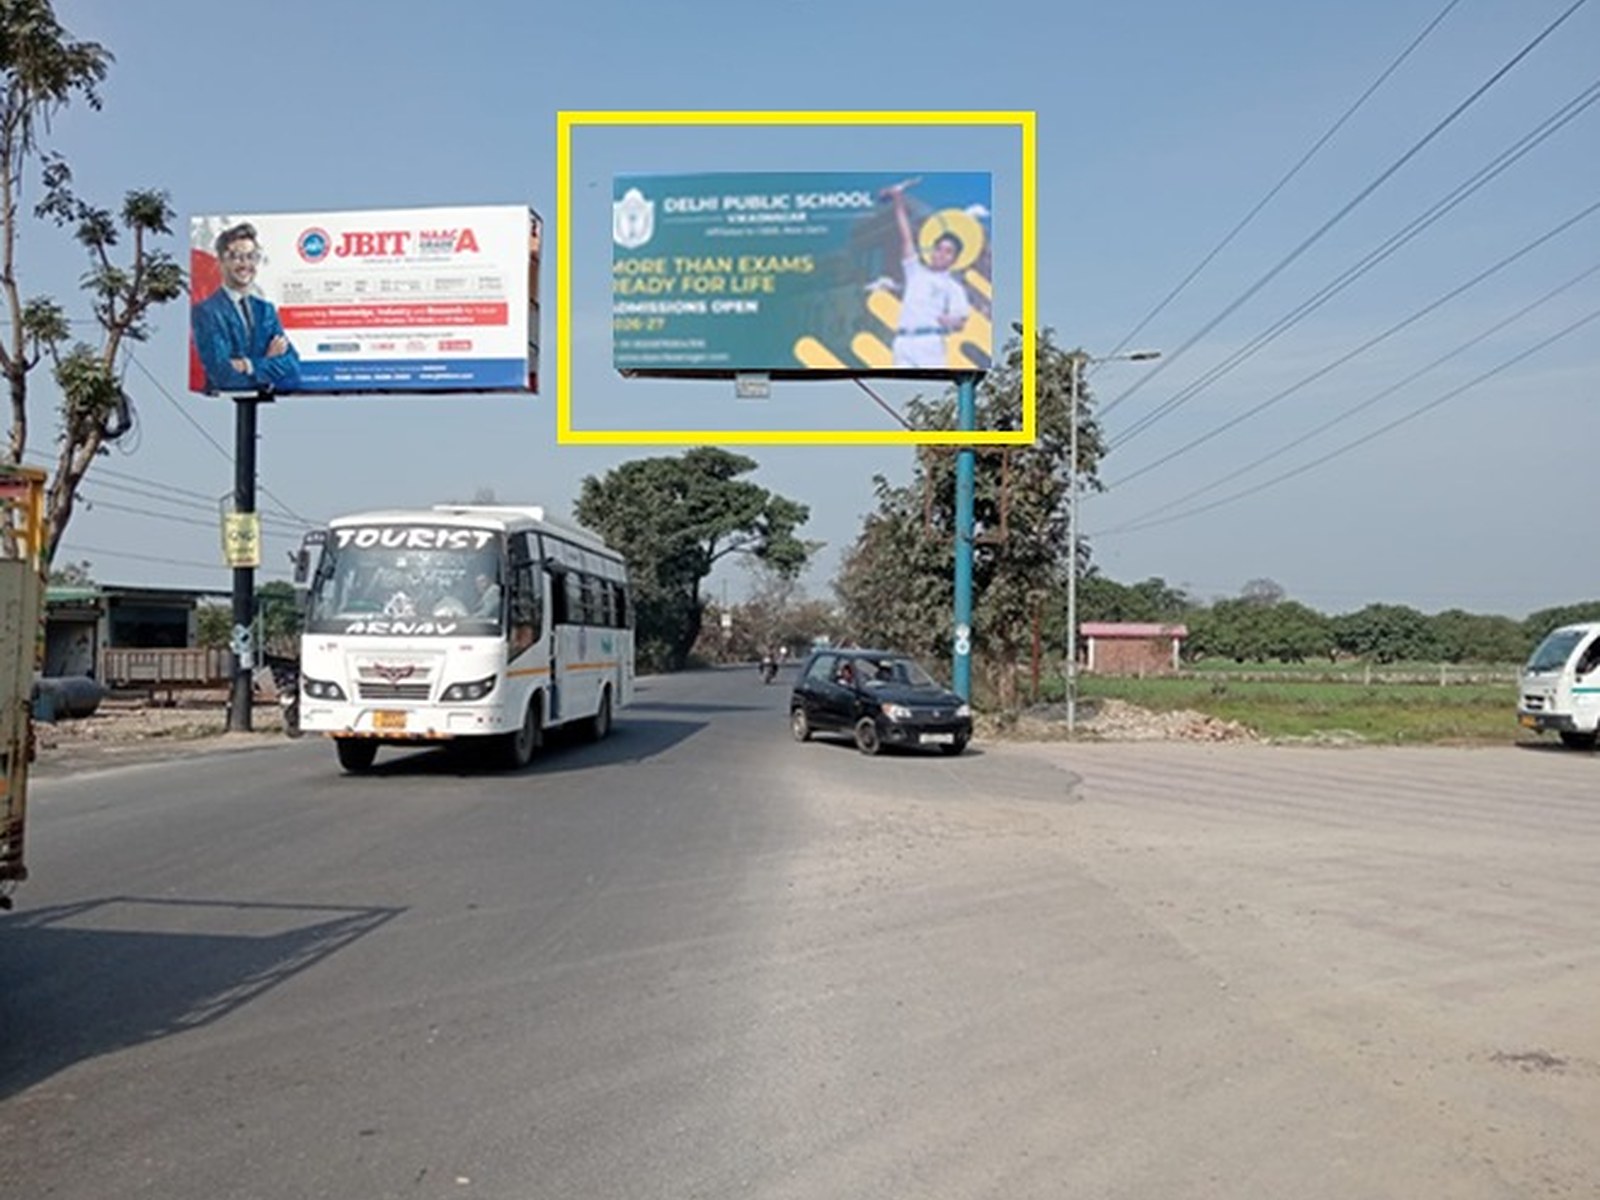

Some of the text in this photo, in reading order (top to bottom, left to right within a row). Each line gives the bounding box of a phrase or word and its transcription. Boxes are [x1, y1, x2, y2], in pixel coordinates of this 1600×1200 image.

[663, 192, 873, 212] DELHI PUBLIC SCHOOL
[335, 230, 410, 257] JBIT
[455, 228, 479, 252] A
[674, 256, 732, 273] THAN
[738, 254, 815, 273] EXAMS
[681, 276, 726, 293] FOR
[730, 275, 776, 292] LIFE
[710, 300, 759, 314] OPEN
[336, 528, 494, 549] TOURIST
[346, 622, 457, 635] ARNAV
